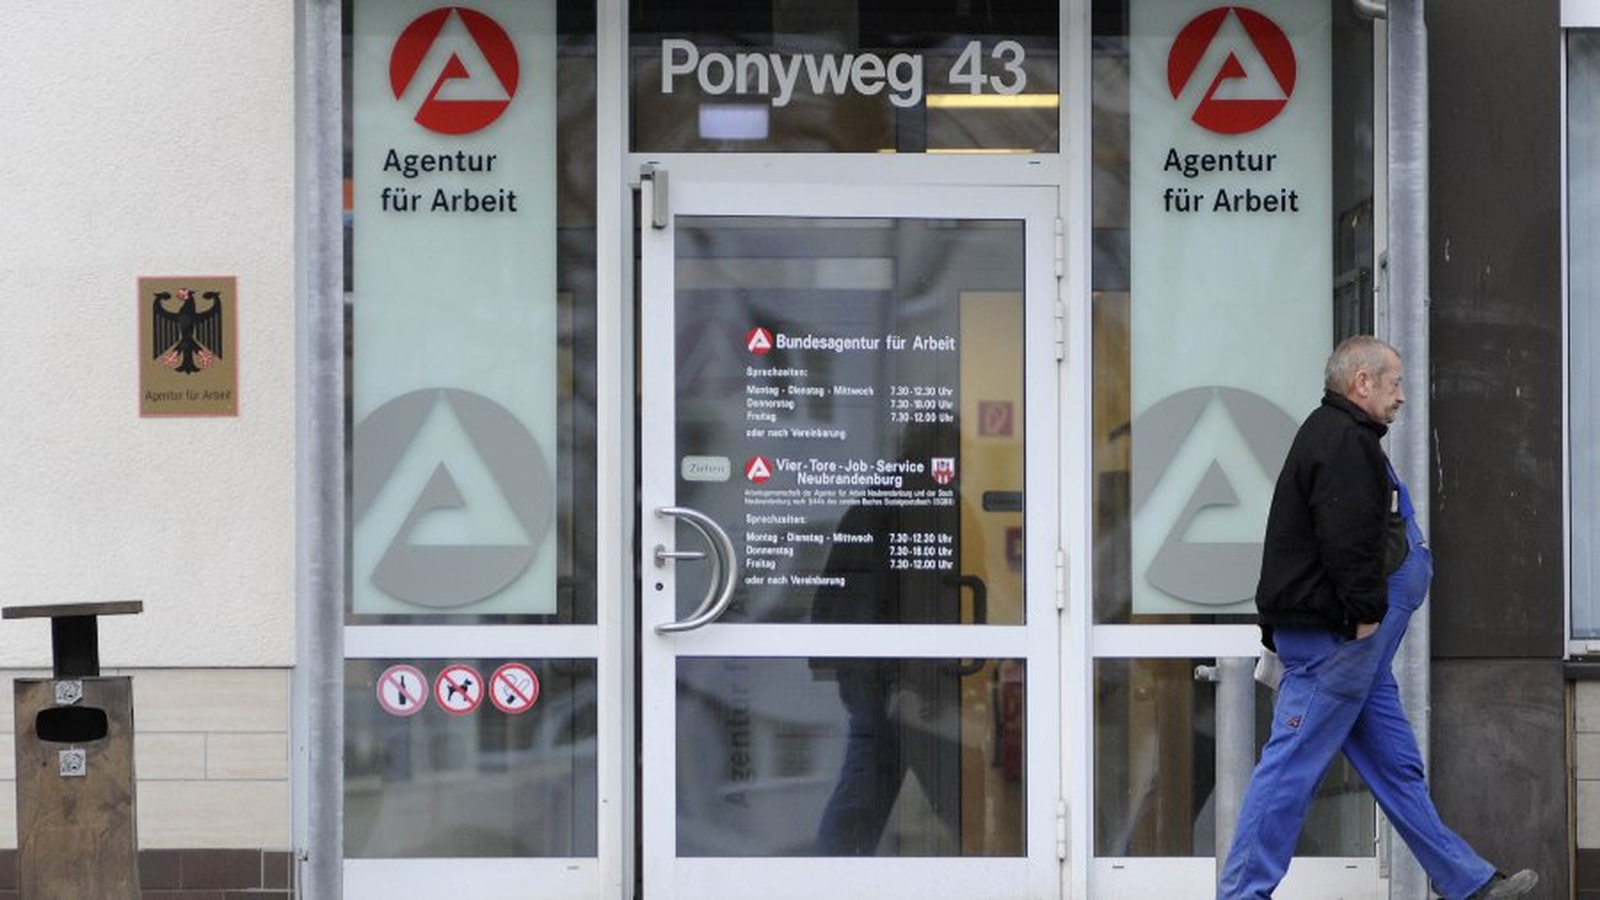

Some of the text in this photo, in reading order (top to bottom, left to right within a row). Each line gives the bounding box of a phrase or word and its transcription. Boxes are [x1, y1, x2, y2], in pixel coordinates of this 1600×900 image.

[661, 38, 1027, 108] Ponyweg 43
[382, 148, 498, 179] Agentur
[1163, 148, 1277, 179] Agentur
[381, 188, 518, 213] für Arbeit
[1163, 188, 1299, 213] für Arbeit
[776, 333, 956, 352] Bundesagentur für Arbeit
[746, 366, 808, 379] Sprechzeiten:
[145, 388, 231, 402] Agentur für Arbeit
[746, 386, 779, 397] Montag
[787, 386, 825, 397] Dienstag
[833, 386, 874, 397] Mittwoch
[938, 386, 954, 397] Uhr
[746, 399, 795, 410] Donnerstag
[938, 399, 954, 410] Uhr
[746, 412, 777, 423] Freitag
[938, 412, 954, 423] Uhr
[746, 428, 846, 440] oder nach Vereinbarung
[797, 473, 903, 488] Neubrandenburg
[746, 533, 779, 544] Montag
[787, 533, 824, 544] Dienstag
[833, 533, 874, 544] Mittwoch
[938, 533, 953, 544] Uhr
[746, 546, 794, 557] Donnerstag
[938, 546, 953, 557] Uhr
[746, 559, 776, 570] Freitag
[938, 559, 953, 570] Uhr
[744, 575, 846, 588] oder nach Vereinbarung
